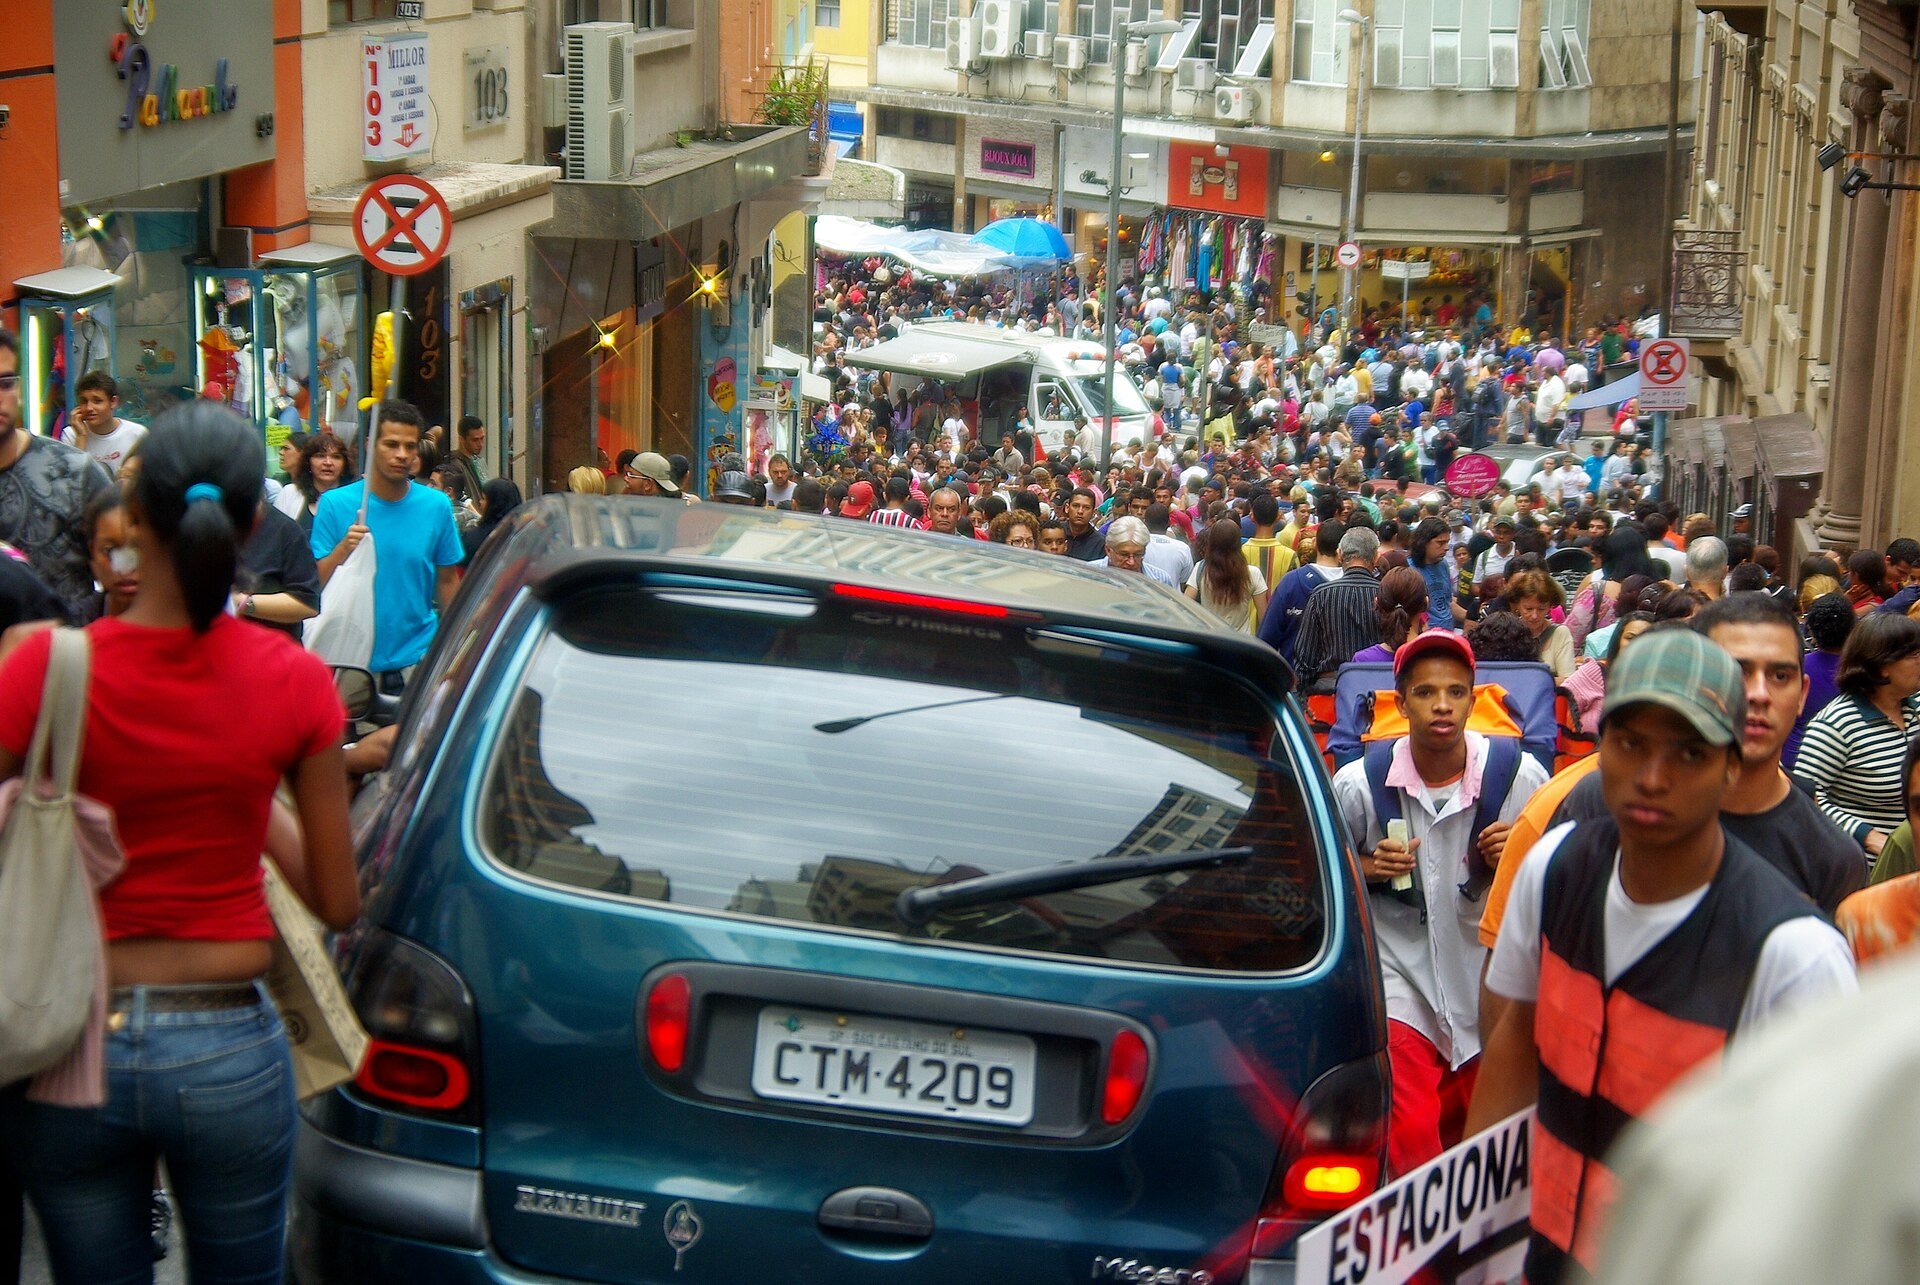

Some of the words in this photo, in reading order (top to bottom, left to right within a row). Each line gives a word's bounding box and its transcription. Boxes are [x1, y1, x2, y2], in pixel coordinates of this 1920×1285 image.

[388, 46, 425, 69] MILLOR
[474, 67, 507, 121] 103
[984, 149, 1010, 165] BIJOUX
[420, 286, 440, 380] 103
[896, 615, 1003, 641] Primarca
[514, 1185, 646, 1228] RENAULT
[1328, 1114, 1528, 1285] ESTACIONA
